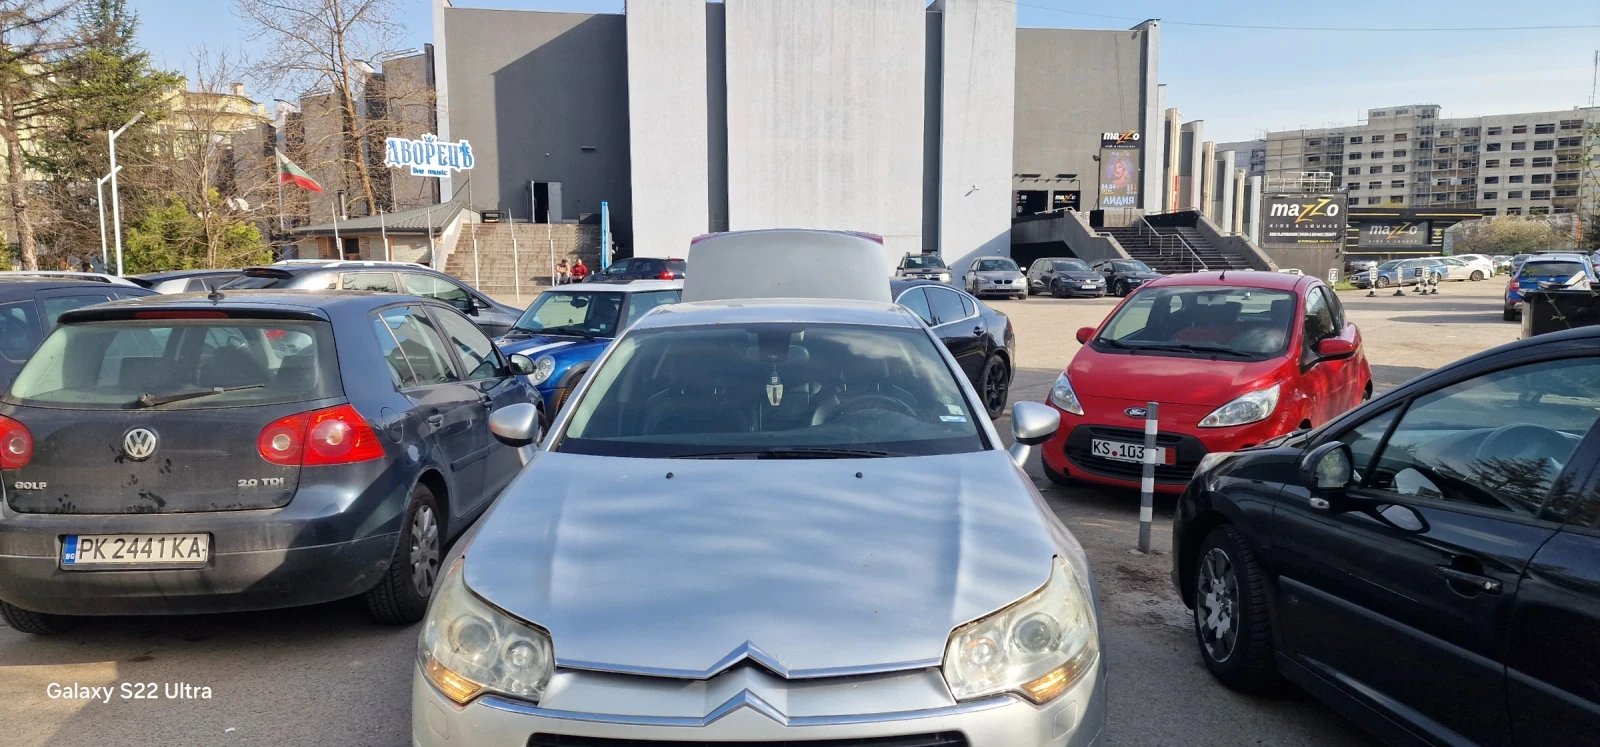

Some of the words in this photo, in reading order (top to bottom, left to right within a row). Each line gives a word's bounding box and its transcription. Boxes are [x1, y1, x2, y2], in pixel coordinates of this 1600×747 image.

[1103, 196, 1135, 206] ЛИДИЯ
[1093, 441, 1110, 455] KS
[14, 481, 47, 489] GOLF
[260, 477, 284, 486] TDI
[79, 538, 108, 560] PK
[111, 537, 165, 560] 2441
[171, 537, 201, 558] KA
[65, 552, 75, 560] BG
